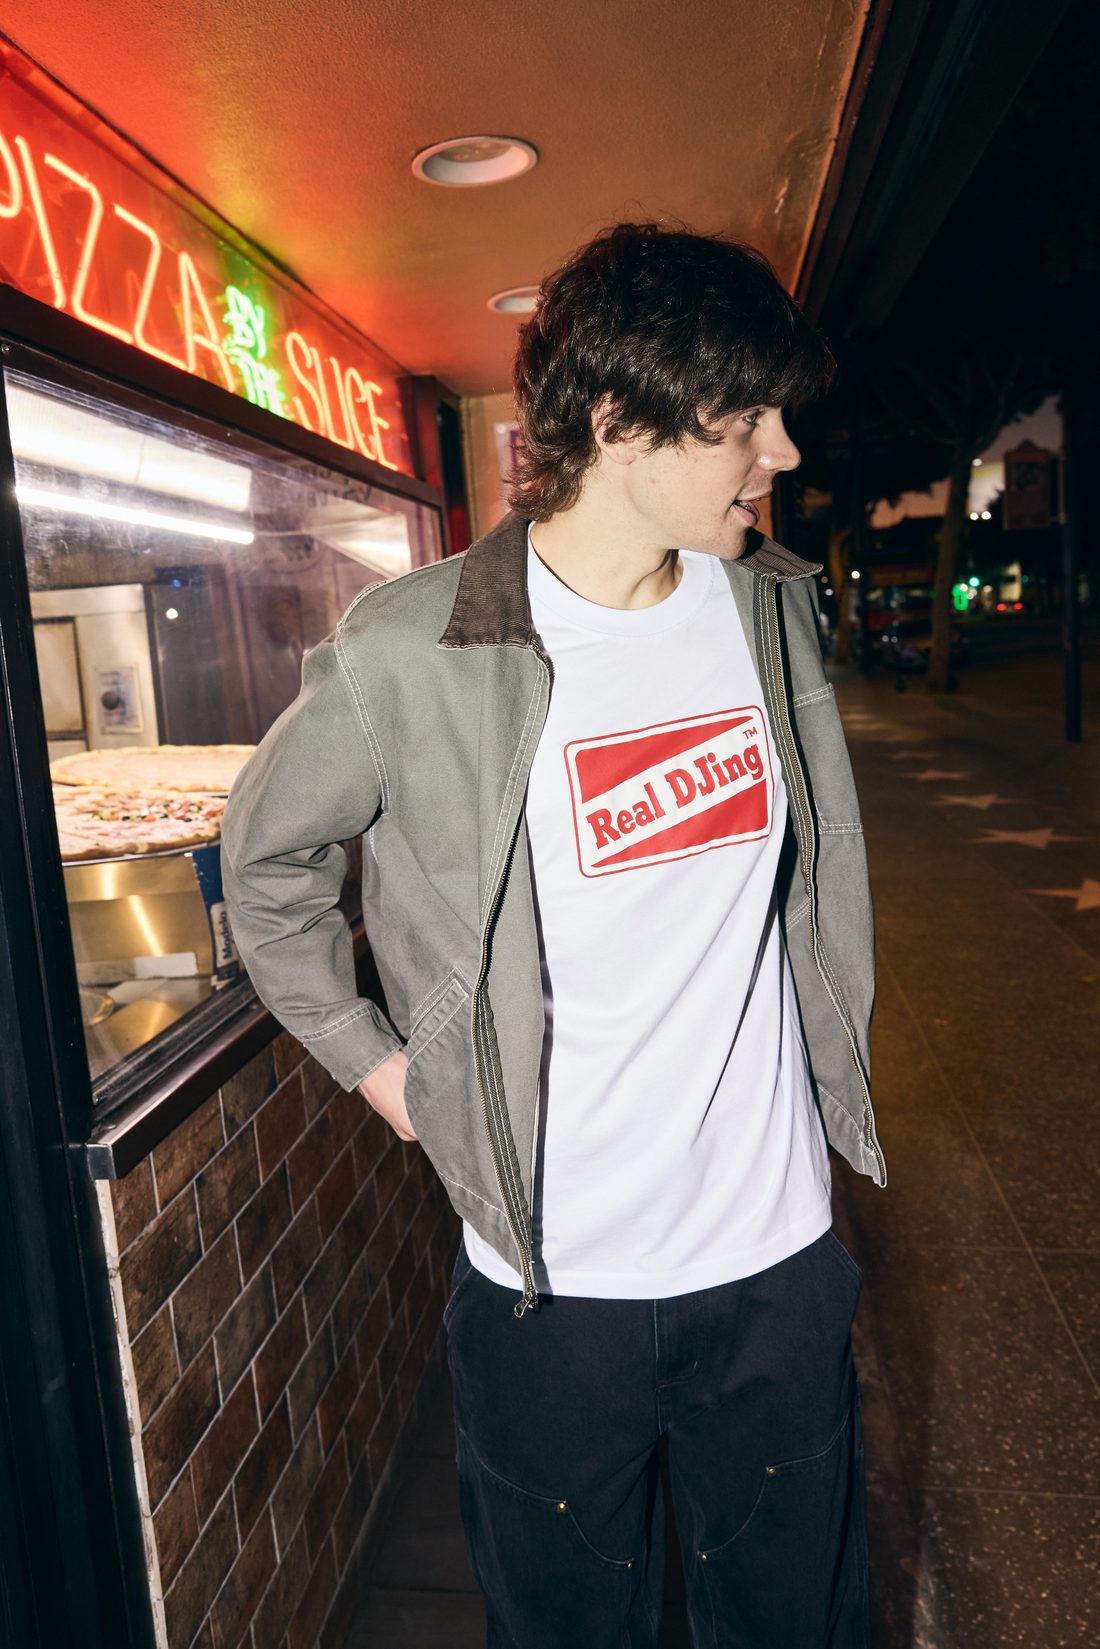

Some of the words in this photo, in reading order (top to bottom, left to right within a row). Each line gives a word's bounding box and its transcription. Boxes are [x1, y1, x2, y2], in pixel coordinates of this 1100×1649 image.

[223, 285, 266, 358] BY
[285, 331, 399, 471] SLICE
[585, 782, 666, 850] Real
[664, 743, 764, 809] DJing
[219, 912, 232, 959] Modelo
